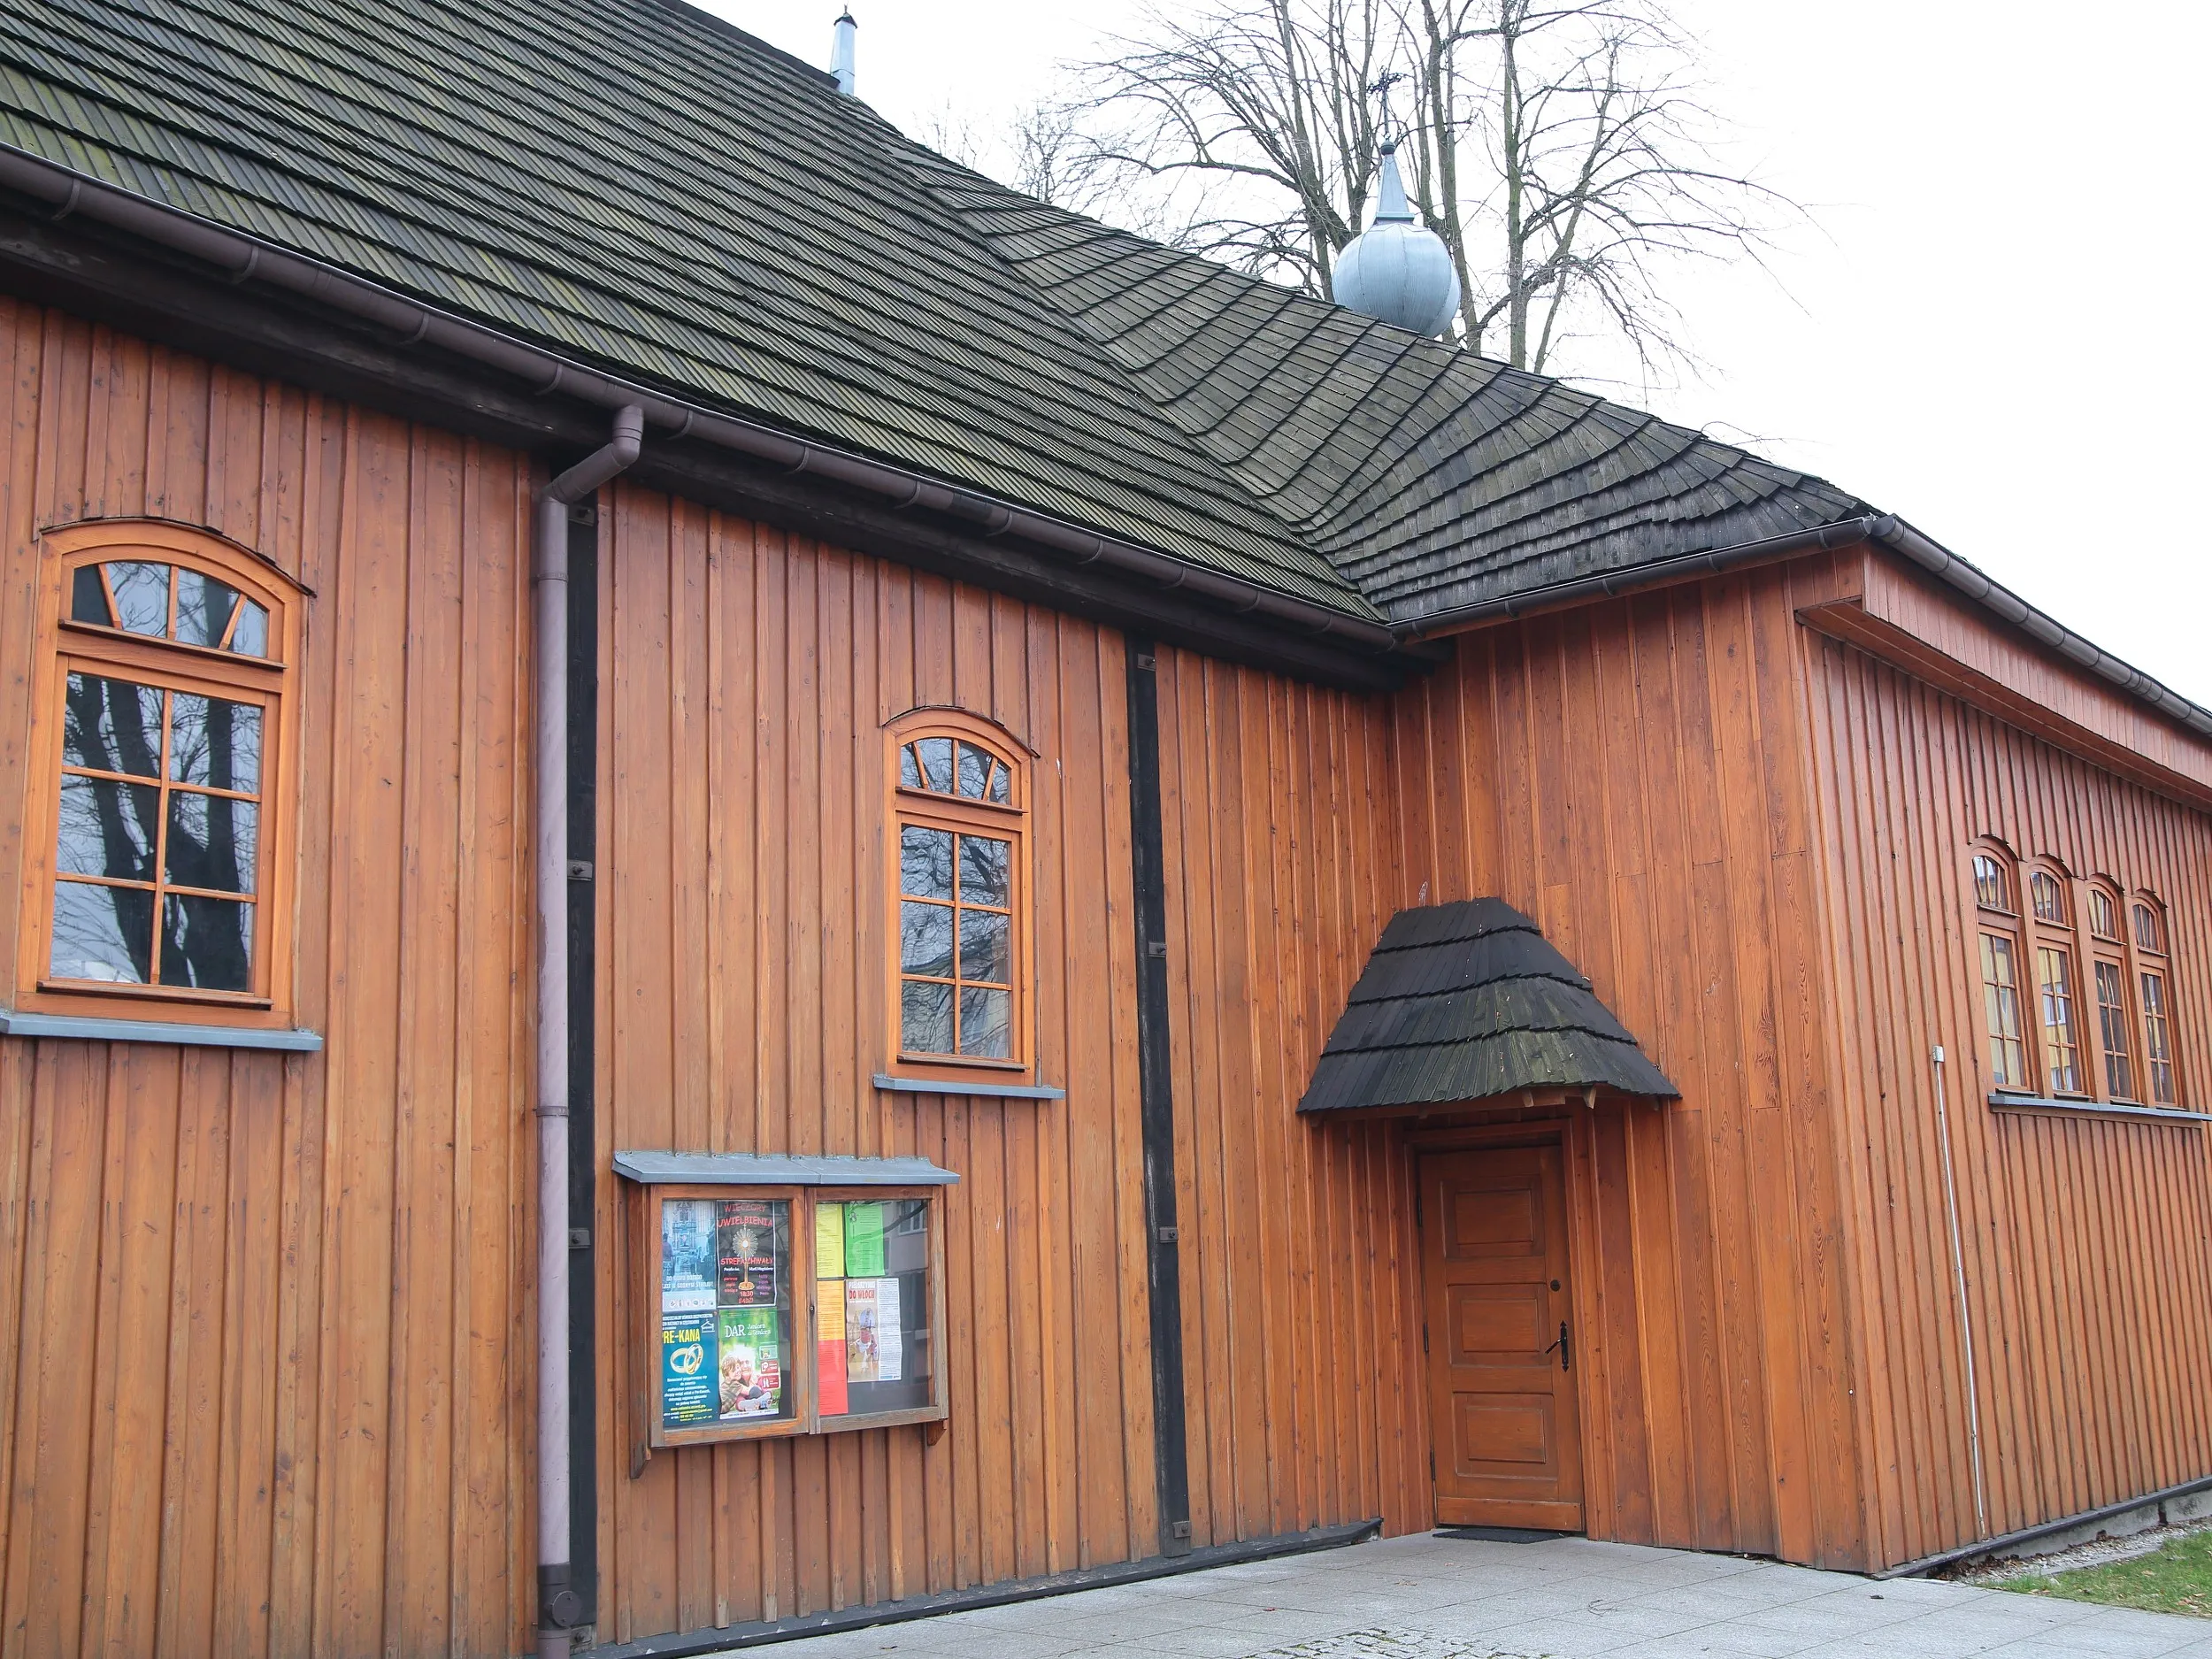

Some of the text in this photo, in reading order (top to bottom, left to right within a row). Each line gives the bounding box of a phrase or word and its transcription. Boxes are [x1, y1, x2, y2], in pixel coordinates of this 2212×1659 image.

[718, 1216, 772, 1227] UWIELBIENIA
[849, 1289, 875, 1299] DO WŁOCH
[662, 1328, 701, 1344] RE-KANA
[724, 1324, 747, 1338] DAR
